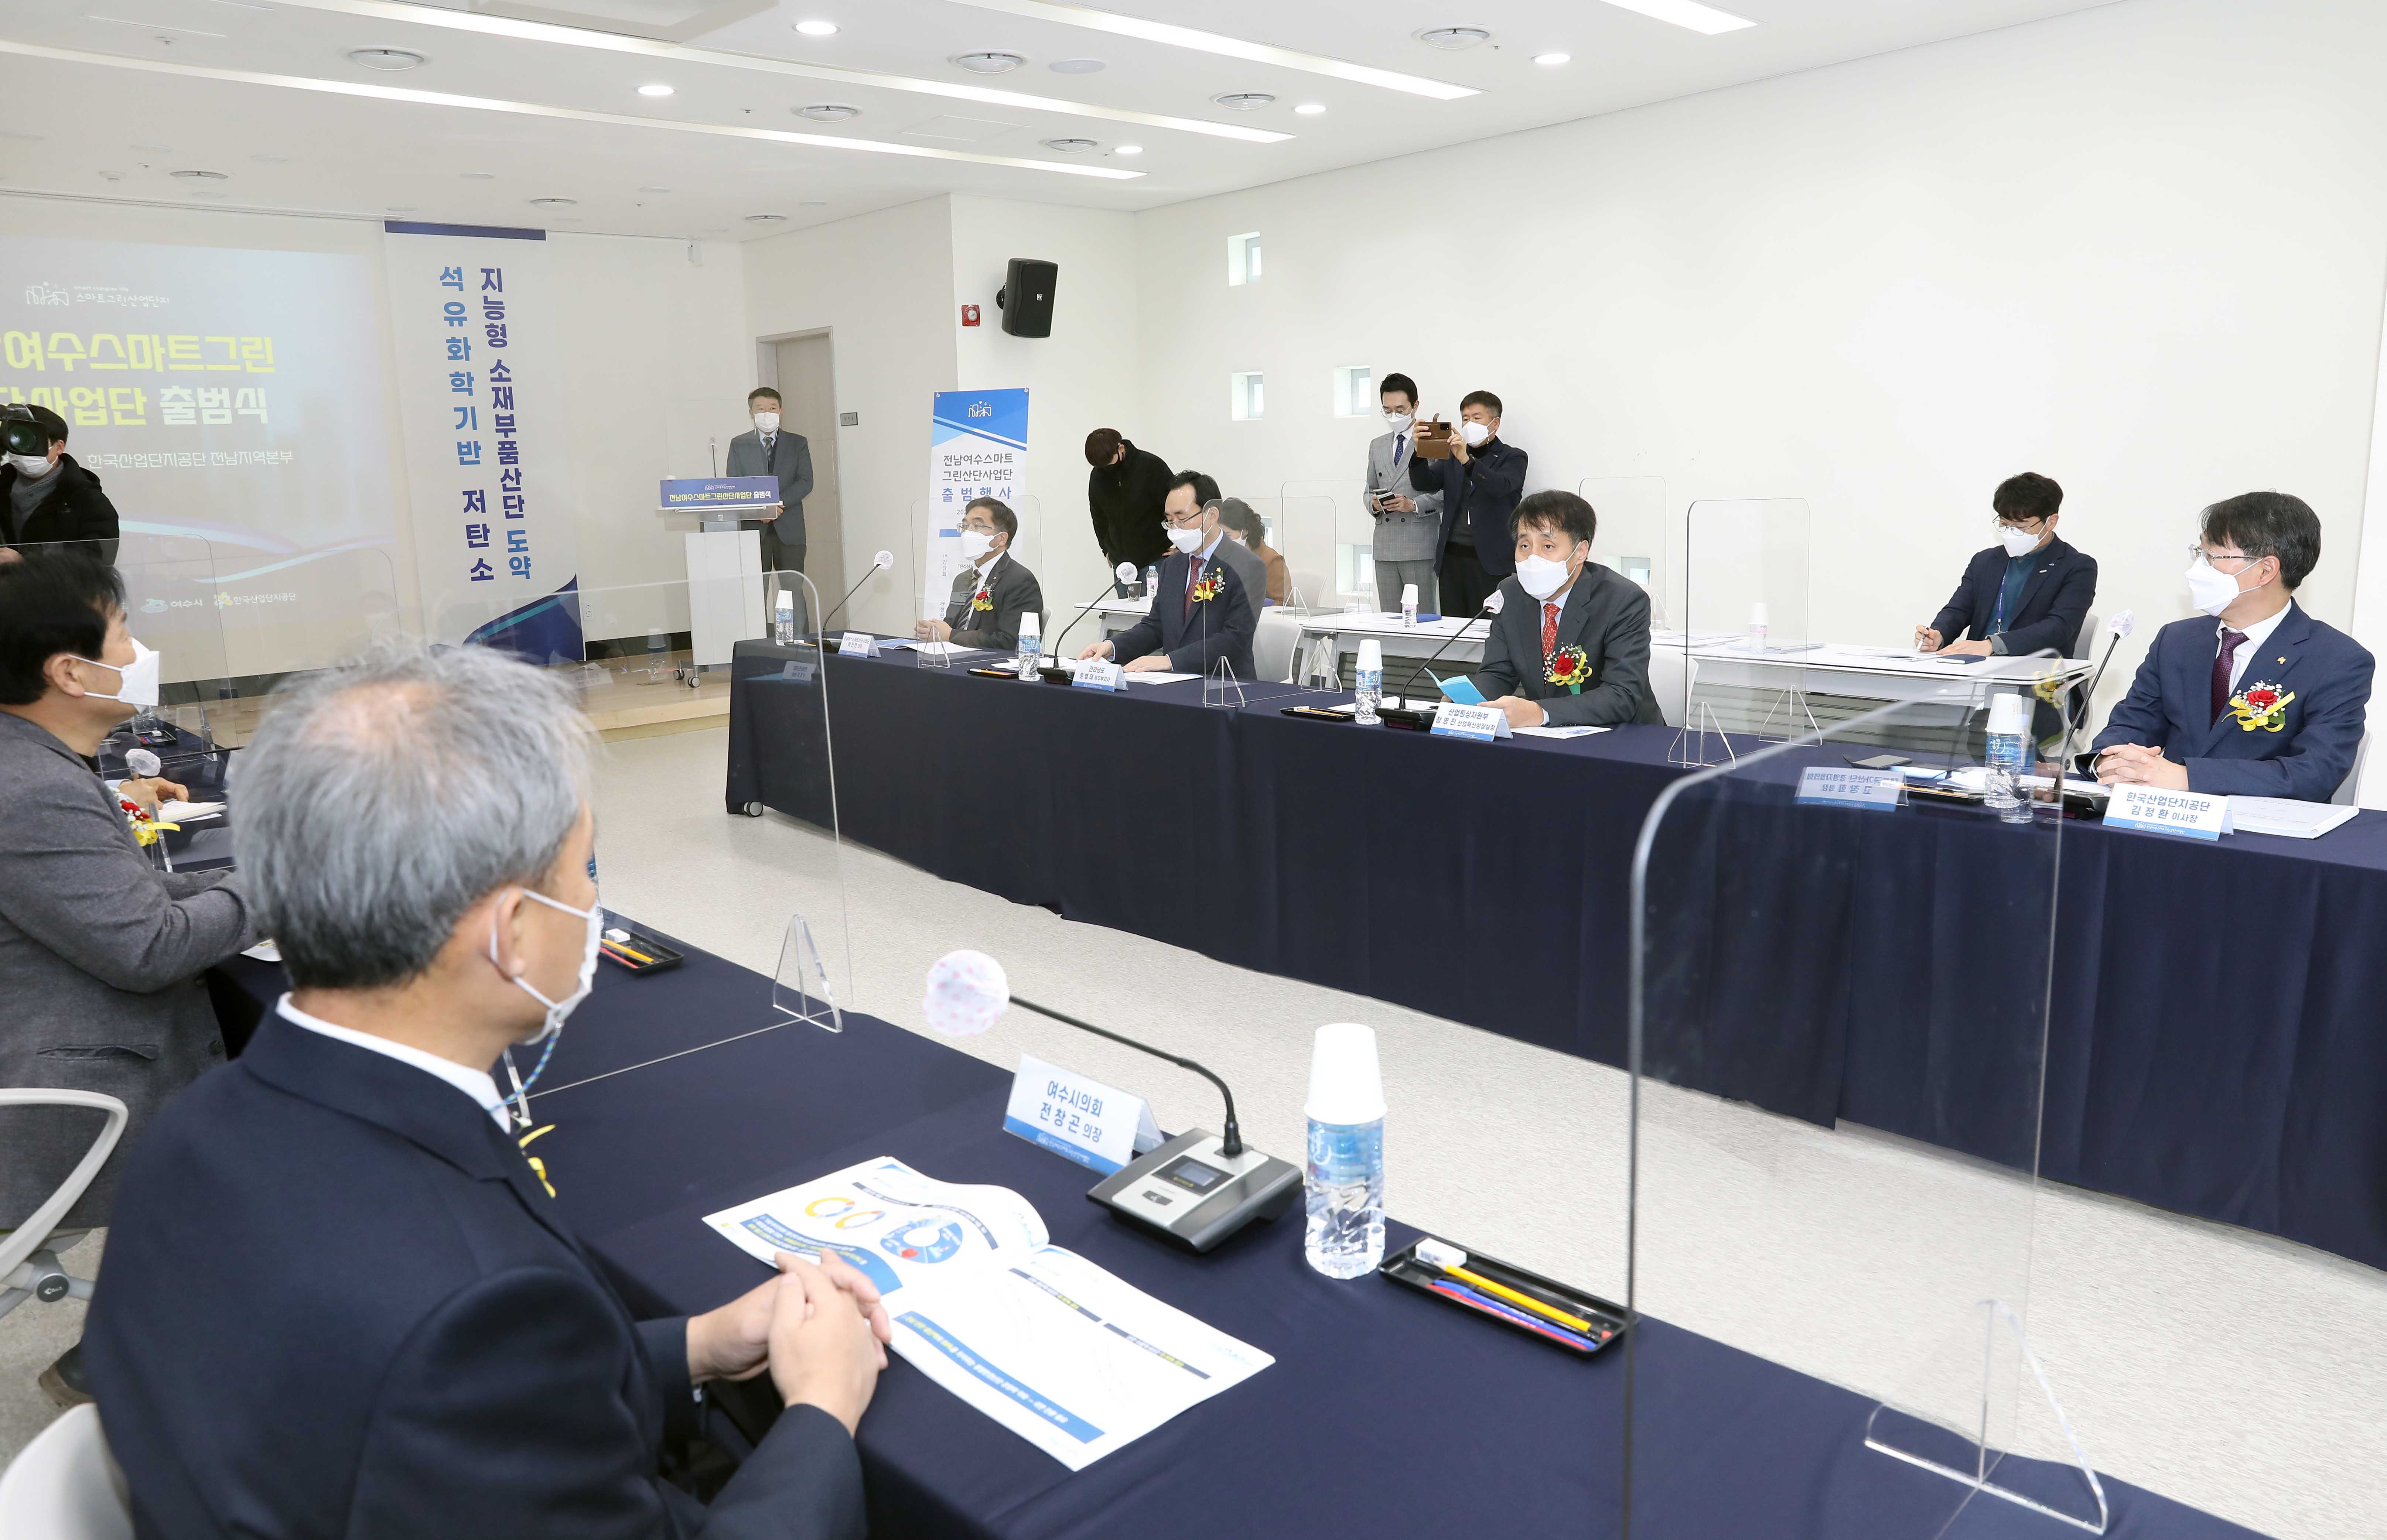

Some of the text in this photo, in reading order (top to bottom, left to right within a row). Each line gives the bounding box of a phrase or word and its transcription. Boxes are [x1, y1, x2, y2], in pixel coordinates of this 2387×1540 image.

[0, 331, 275, 373] 여수스마트그린
[160, 386, 269, 425] 출범식
[440, 266, 494, 582] 석유화학기반 저탄소
[480, 267, 531, 579] 지능형 소재부품산단 도약
[87, 450, 293, 468] 한국산업단지공단 전남지역본부
[943, 453, 1013, 466] 전남여수스마트
[942, 469, 1012, 482] 그린산단사업단
[171, 599, 203, 608] 여수시
[1448, 709, 1489, 720] 산업통상자원부
[1458, 721, 1495, 731] 산업혁신성장실장
[2126, 792, 2211, 812] 한국산업단지공단
[2172, 812, 2198, 823] 이사장
[1047, 1081, 1103, 1118] 여수시의회
[1082, 1123, 1102, 1143] 의장
